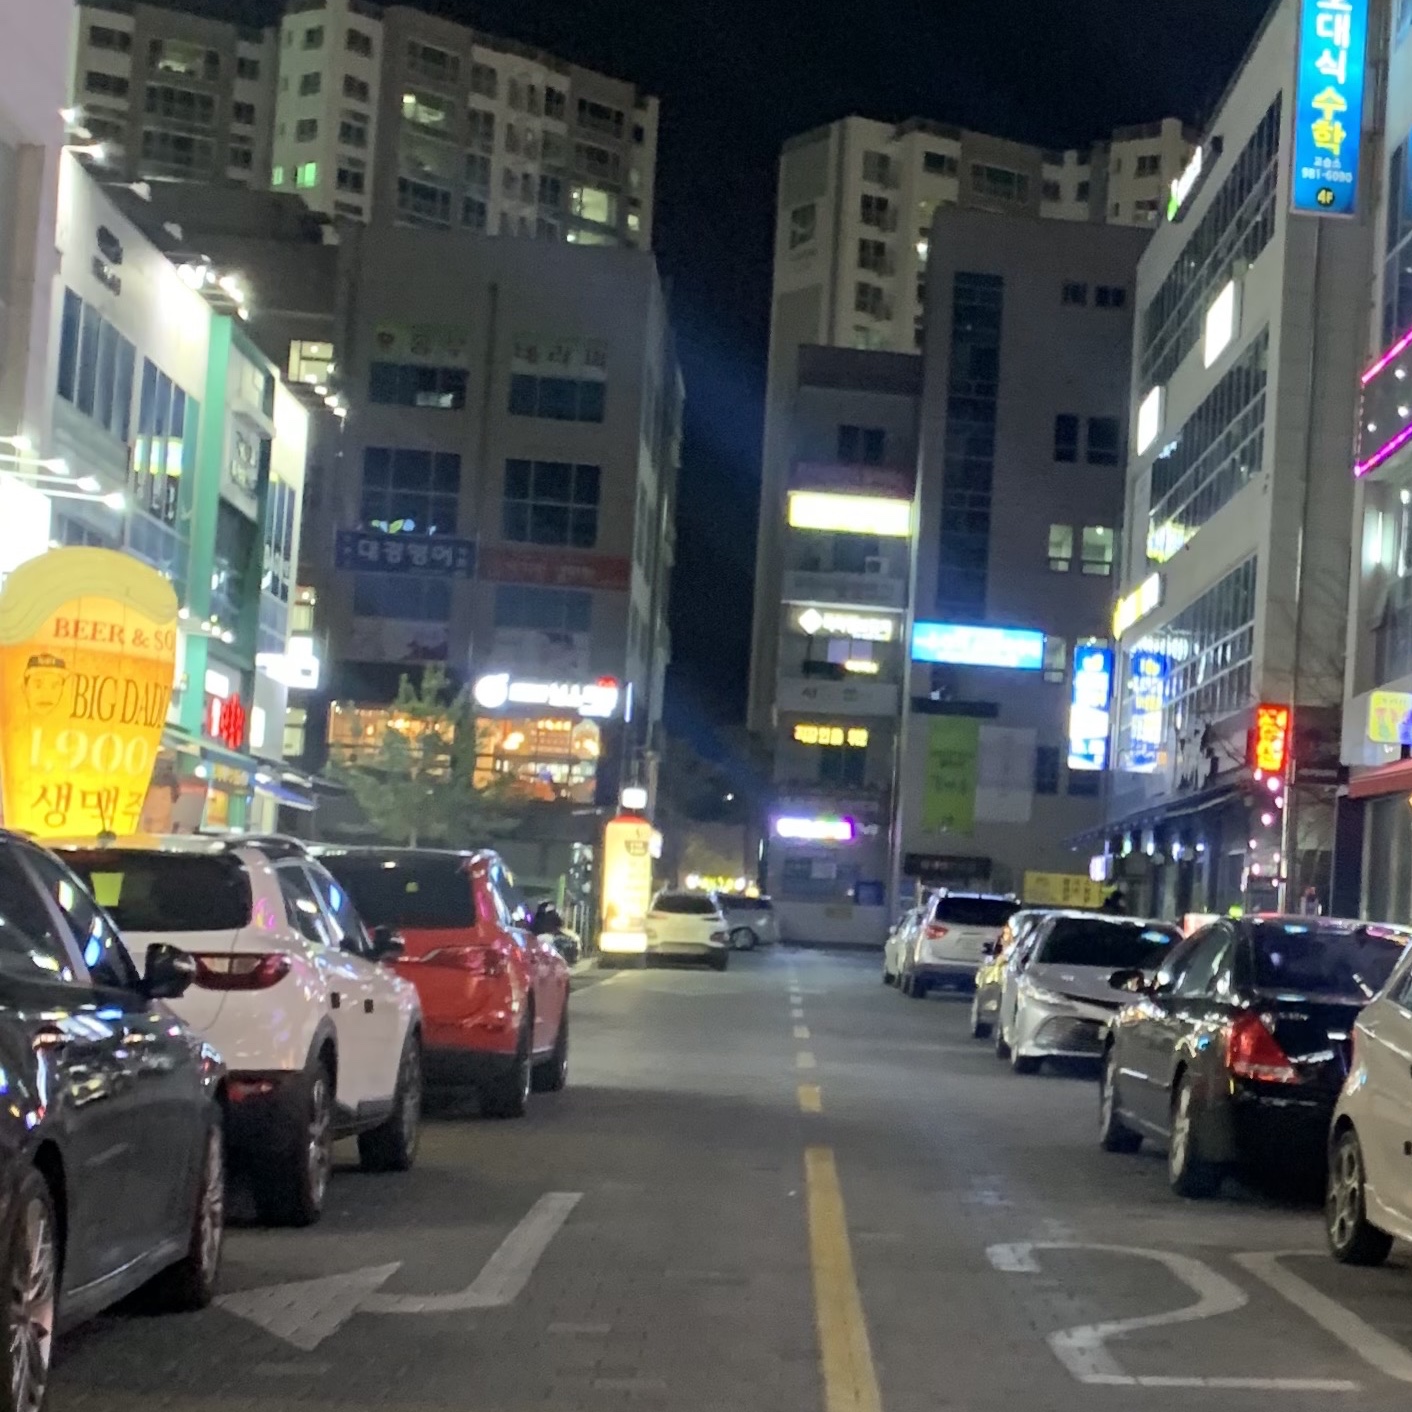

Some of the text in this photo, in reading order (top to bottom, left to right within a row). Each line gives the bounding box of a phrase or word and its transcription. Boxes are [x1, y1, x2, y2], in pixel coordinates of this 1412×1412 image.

[1311, 0, 1352, 157] 대식 수학
[52, 617, 126, 645] BEER
[70, 672, 119, 722] BIG
[119, 678, 169, 729] DAD
